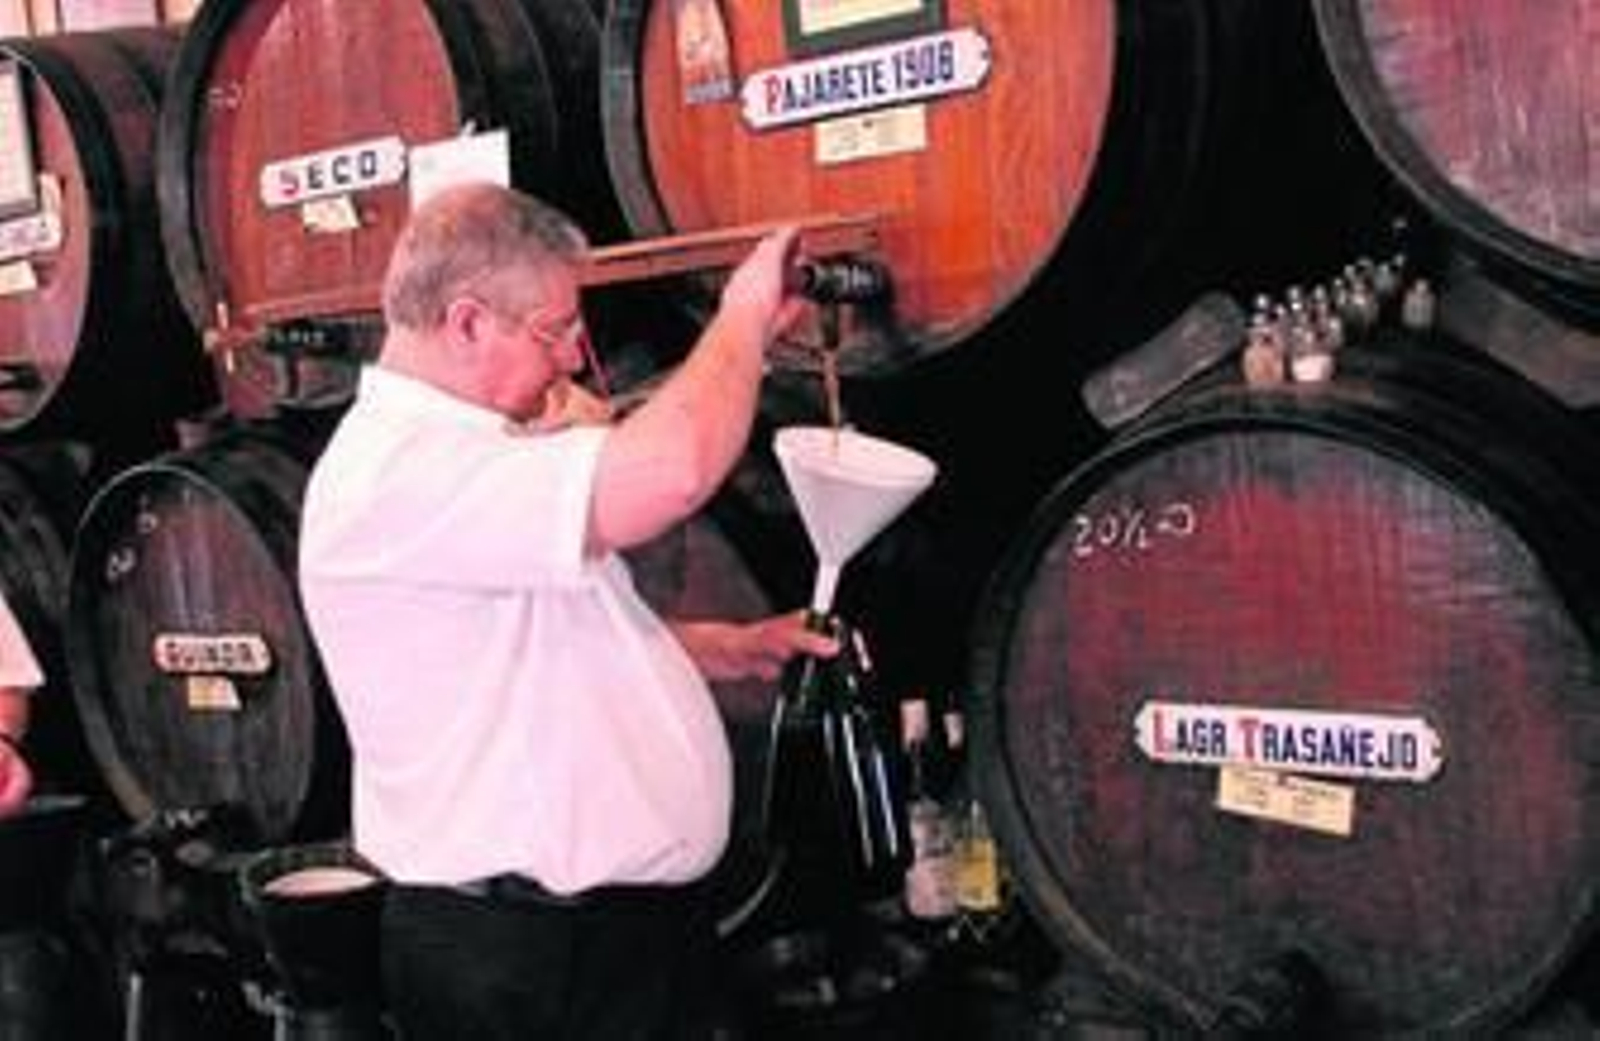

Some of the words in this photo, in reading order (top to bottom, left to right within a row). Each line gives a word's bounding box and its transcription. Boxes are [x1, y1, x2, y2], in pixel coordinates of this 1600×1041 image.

[763, 60, 886, 114] PAJARETE
[278, 151, 377, 197] SECO
[1152, 709, 1228, 761] LAGR
